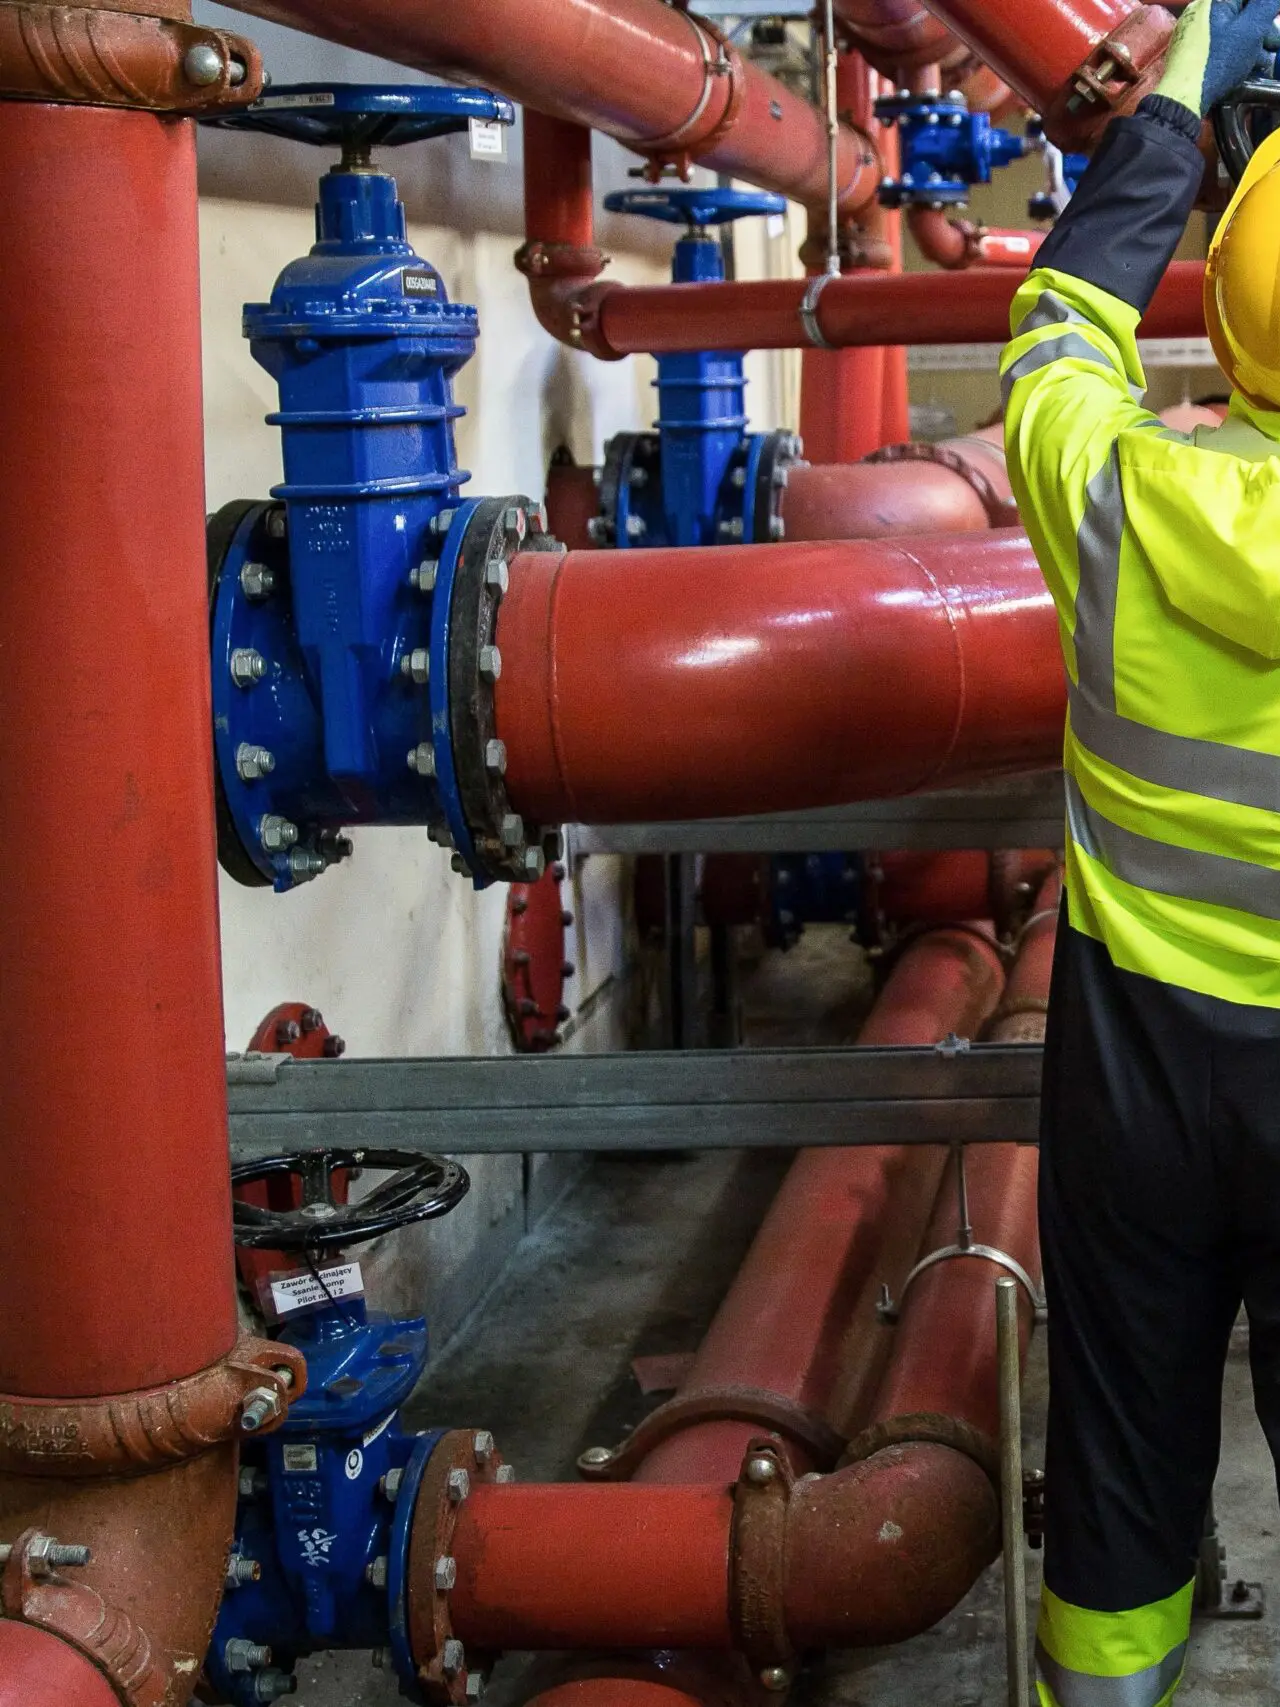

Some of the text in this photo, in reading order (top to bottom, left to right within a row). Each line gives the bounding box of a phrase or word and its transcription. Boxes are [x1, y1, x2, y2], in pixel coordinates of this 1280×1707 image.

[281, 1267, 352, 1290] Zawór ocinający
[292, 1285, 319, 1296] Ssanie
[297, 1295, 317, 1305] Pilot
